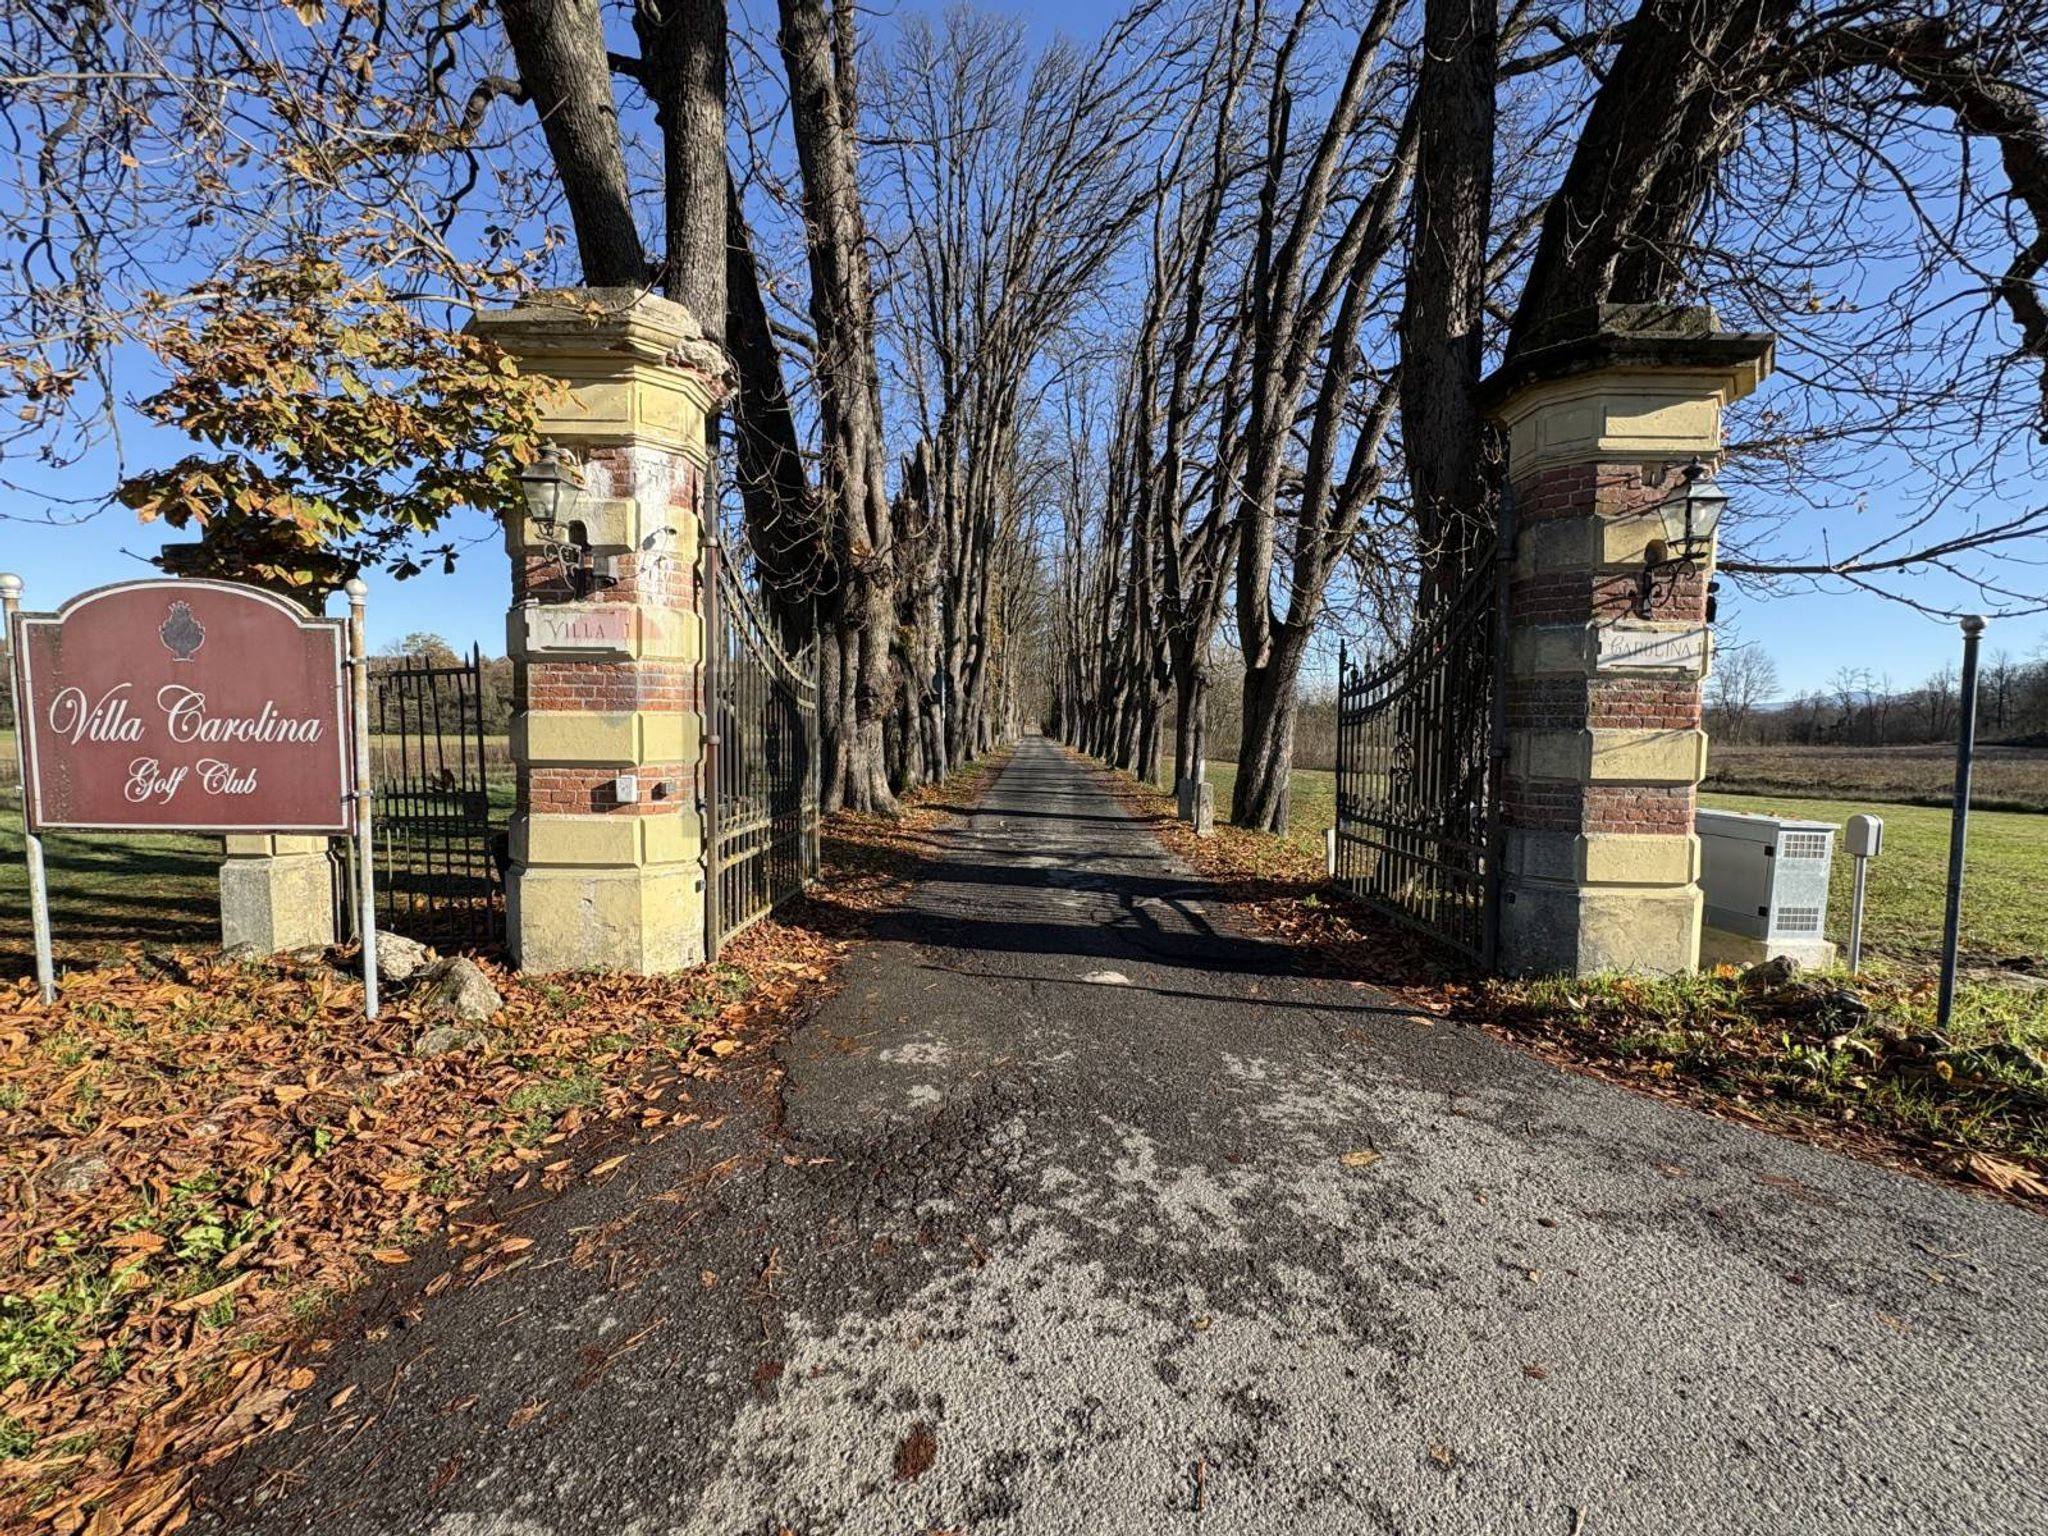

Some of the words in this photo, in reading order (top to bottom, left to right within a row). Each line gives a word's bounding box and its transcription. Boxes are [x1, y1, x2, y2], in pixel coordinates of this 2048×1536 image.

[544, 619, 605, 640] VILLA
[1610, 635, 1692, 657] CAROLINA
[50, 682, 145, 745] Villa
[157, 684, 324, 744] Carolina
[124, 756, 189, 805] Golf
[196, 758, 257, 795] Club
